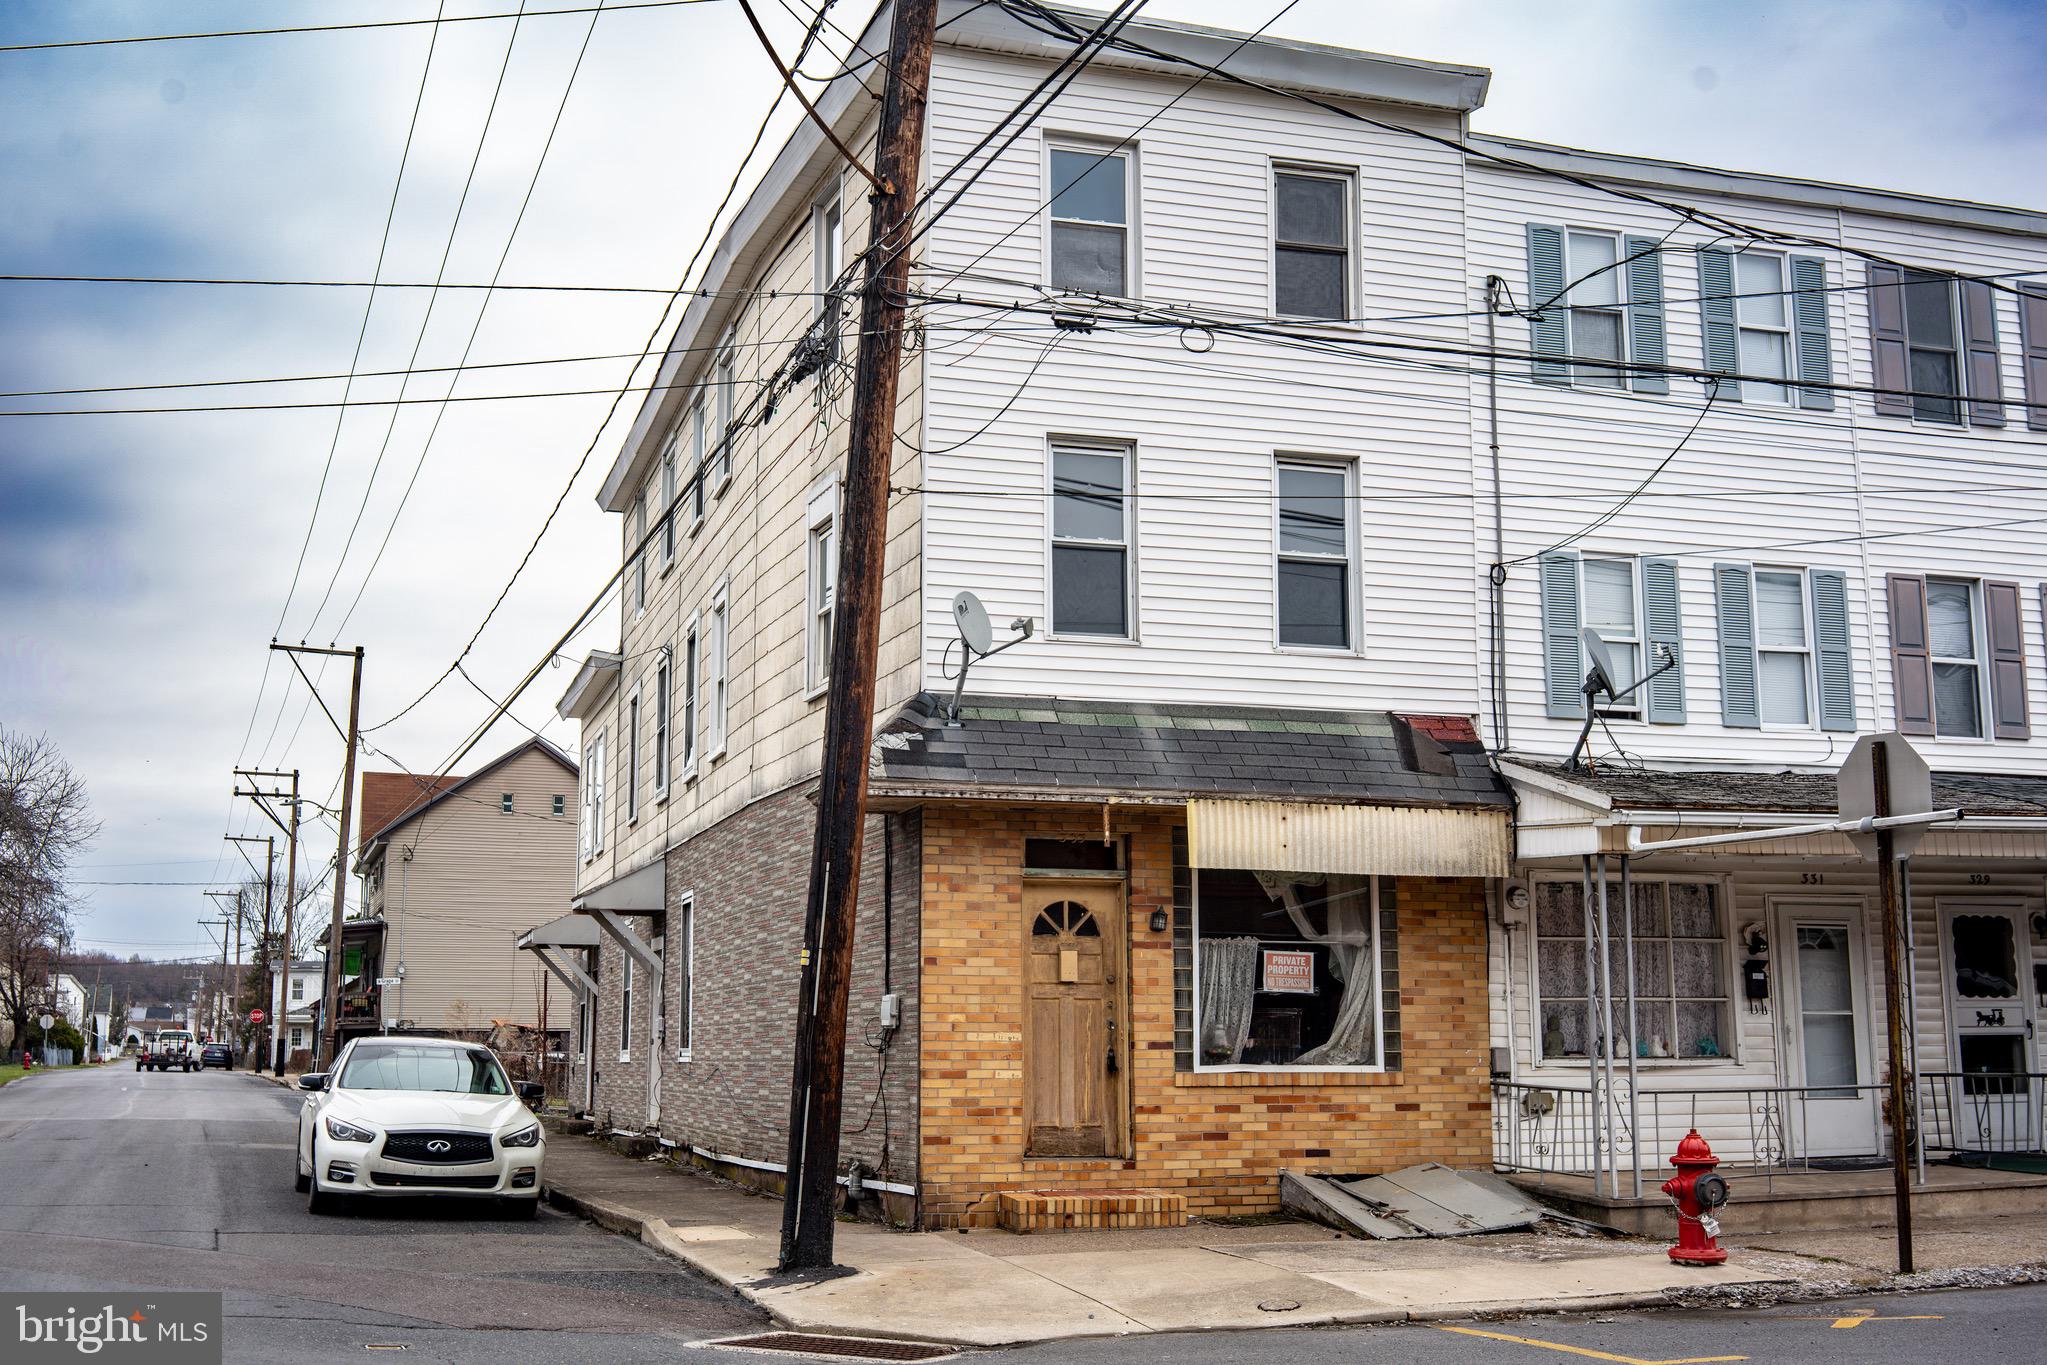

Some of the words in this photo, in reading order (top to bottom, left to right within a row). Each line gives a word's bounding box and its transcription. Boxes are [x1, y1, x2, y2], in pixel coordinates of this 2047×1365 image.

[1800, 873, 1824, 885] 331
[1968, 874, 1991, 886] 329
[1272, 955, 1306, 966] PRIVATE
[1267, 965, 1310, 976] PROPERTY
[1267, 977, 1277, 988] NO
[1278, 977, 1310, 989] TRESPASSING
